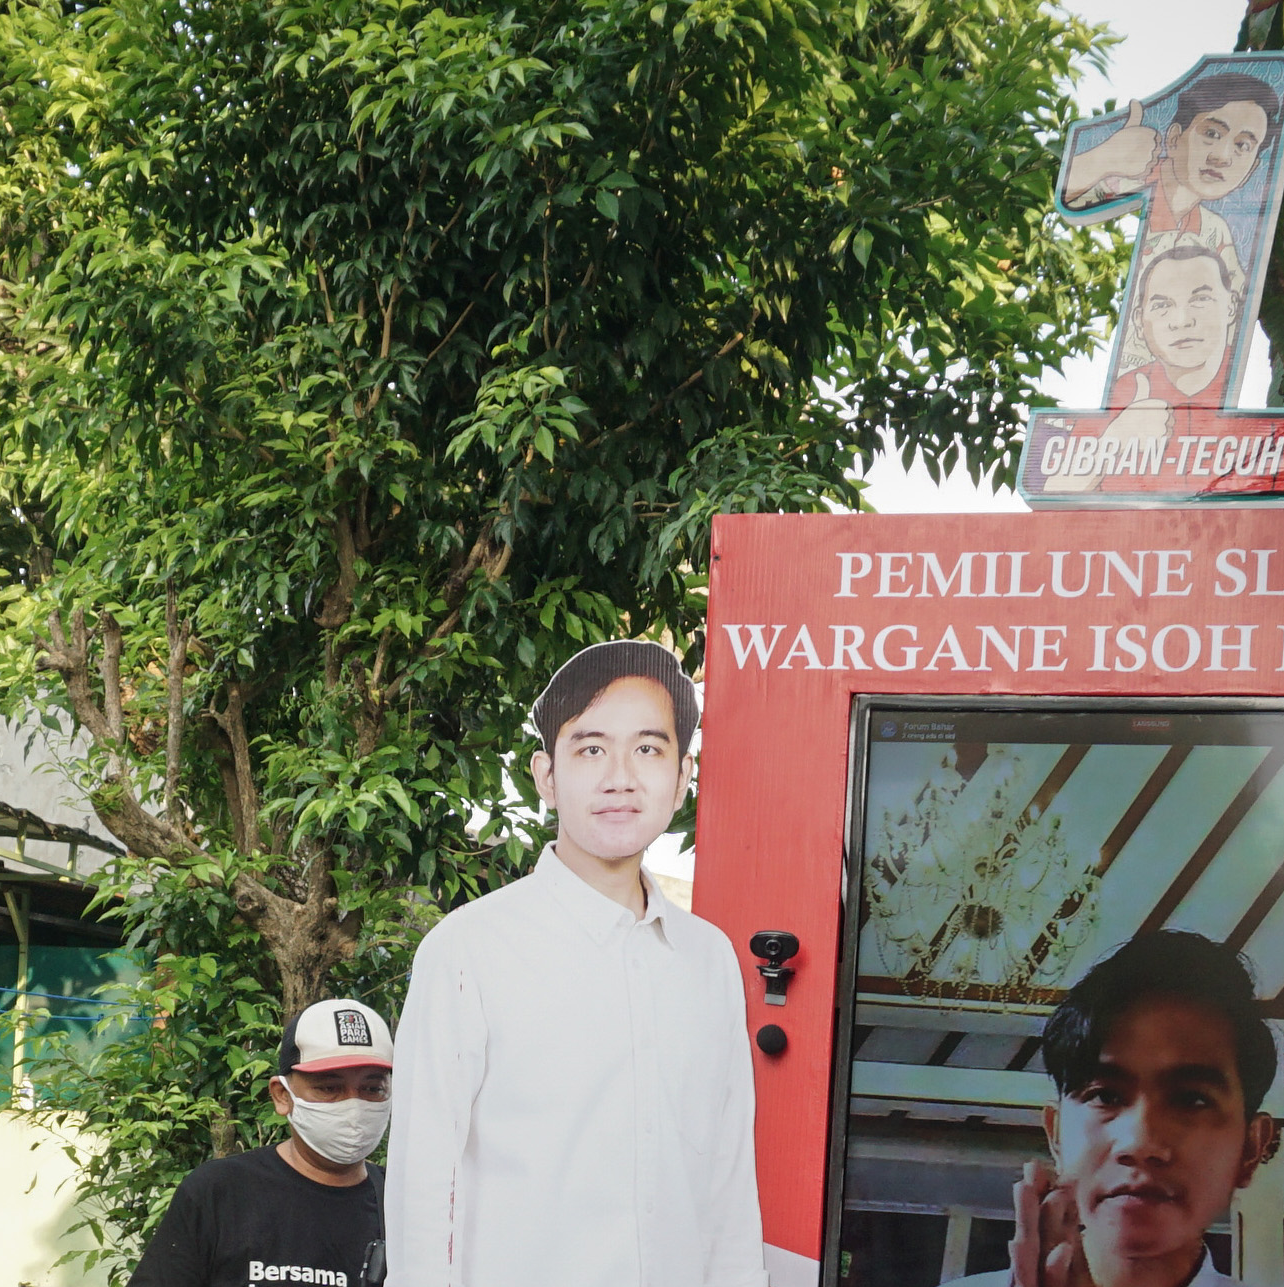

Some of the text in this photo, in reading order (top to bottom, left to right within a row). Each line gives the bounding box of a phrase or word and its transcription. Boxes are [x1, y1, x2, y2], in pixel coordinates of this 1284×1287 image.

[833, 549, 1194, 598] PEMILUNE
[721, 623, 1069, 673] WARGANE
[1086, 623, 1259, 673] ISOH
[341, 1029, 369, 1038] PARA
[342, 1036, 369, 1044] GAMES
[248, 1260, 348, 1287] Bersama
